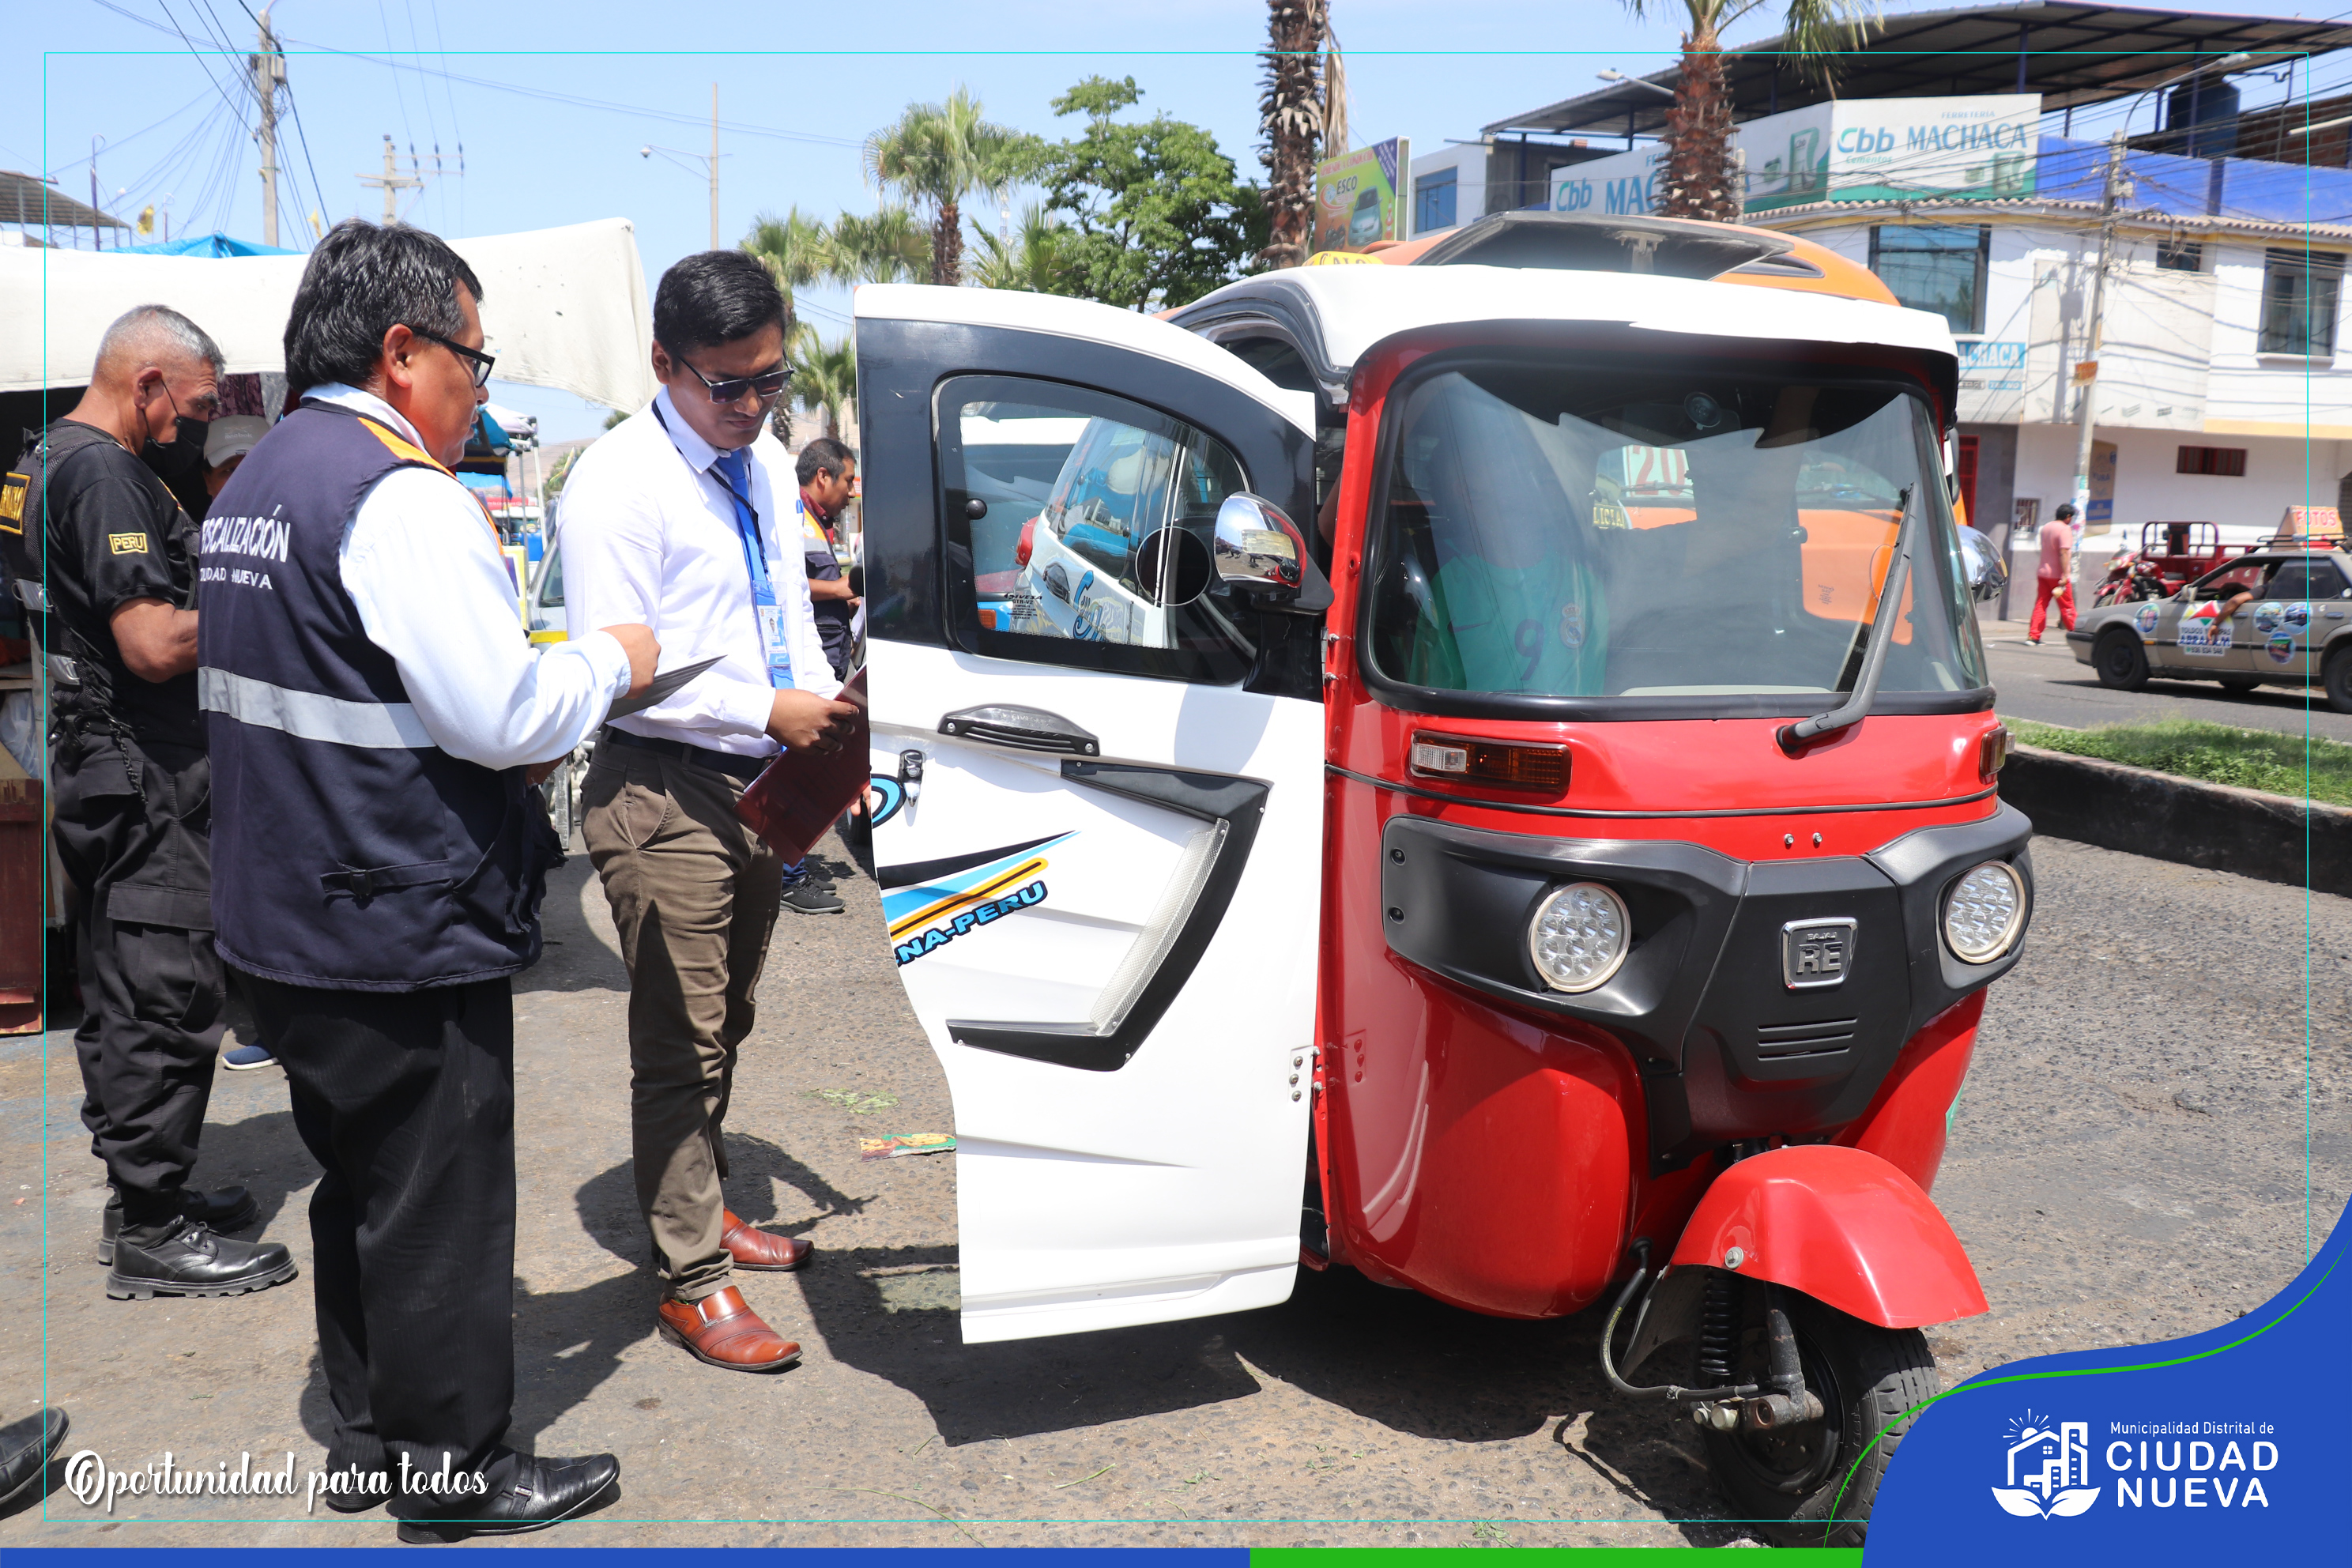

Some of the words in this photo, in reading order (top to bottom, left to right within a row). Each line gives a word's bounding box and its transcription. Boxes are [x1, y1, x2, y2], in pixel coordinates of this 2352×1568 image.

[1838, 126, 1895, 153] Cbb
[1907, 122, 2027, 151] MACHACA
[1846, 154, 1893, 164] Cementos
[1336, 175, 1358, 194] ESCO
[1556, 177, 1592, 212] Cbb
[1958, 343, 2021, 368] ACHACA
[1632, 444, 1685, 496] 20
[1593, 507, 1625, 528] LICIA
[2296, 510, 2337, 528] FOTOS
[113, 536, 143, 551] PERU
[231, 568, 273, 590] NUEVA
[1514, 618, 1545, 681] 9
[895, 880, 1048, 967] NA-PERU
[1796, 940, 1843, 975] RE
